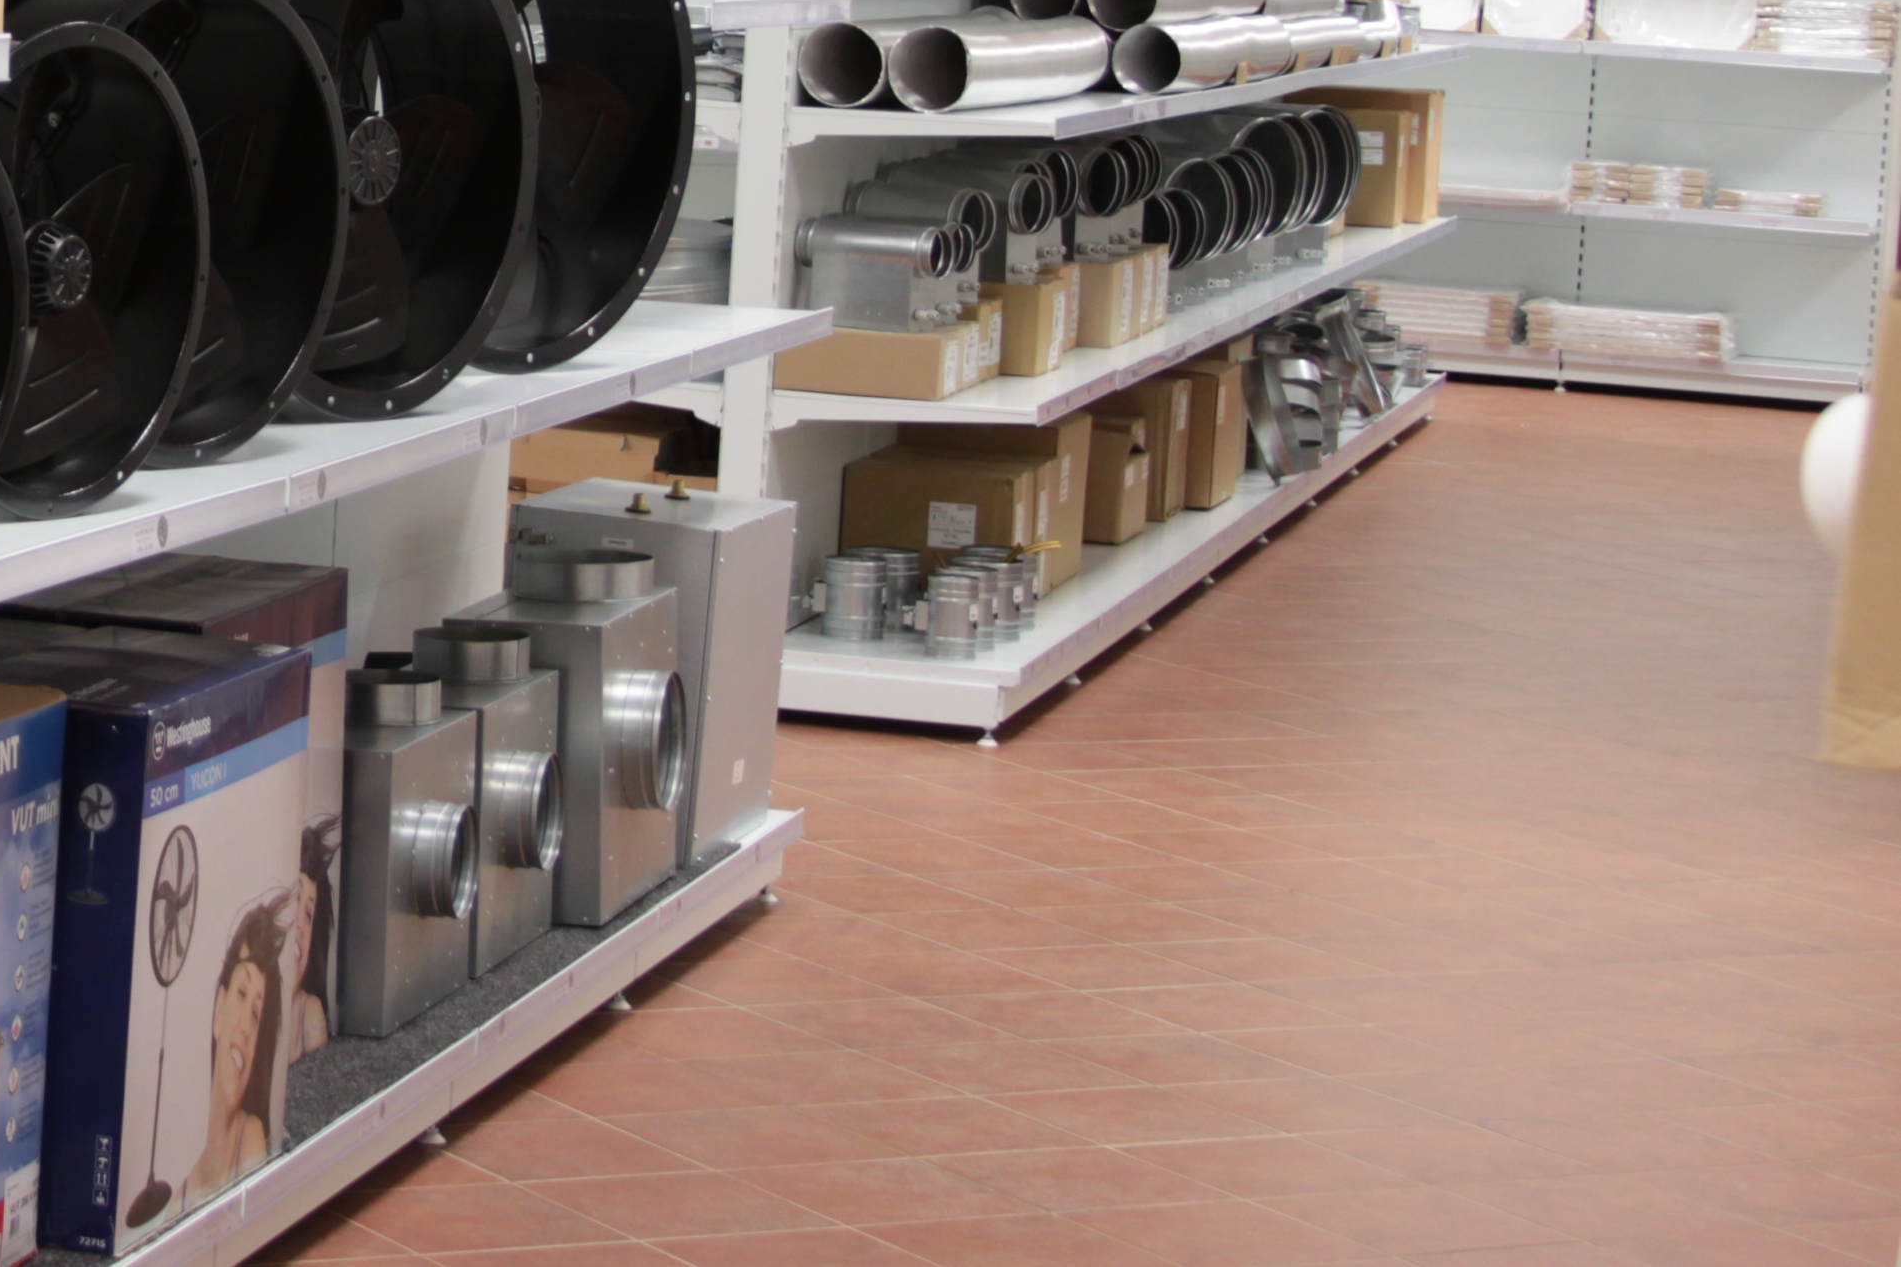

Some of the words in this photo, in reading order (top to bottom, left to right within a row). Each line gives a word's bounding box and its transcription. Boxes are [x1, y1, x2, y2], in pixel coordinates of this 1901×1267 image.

[165, 715, 212, 748] Westinghouse
[191, 764, 222, 791] YUCON
[150, 789, 163, 808] 50
[164, 783, 179, 804] cm
[11, 800, 36, 835] VUT
